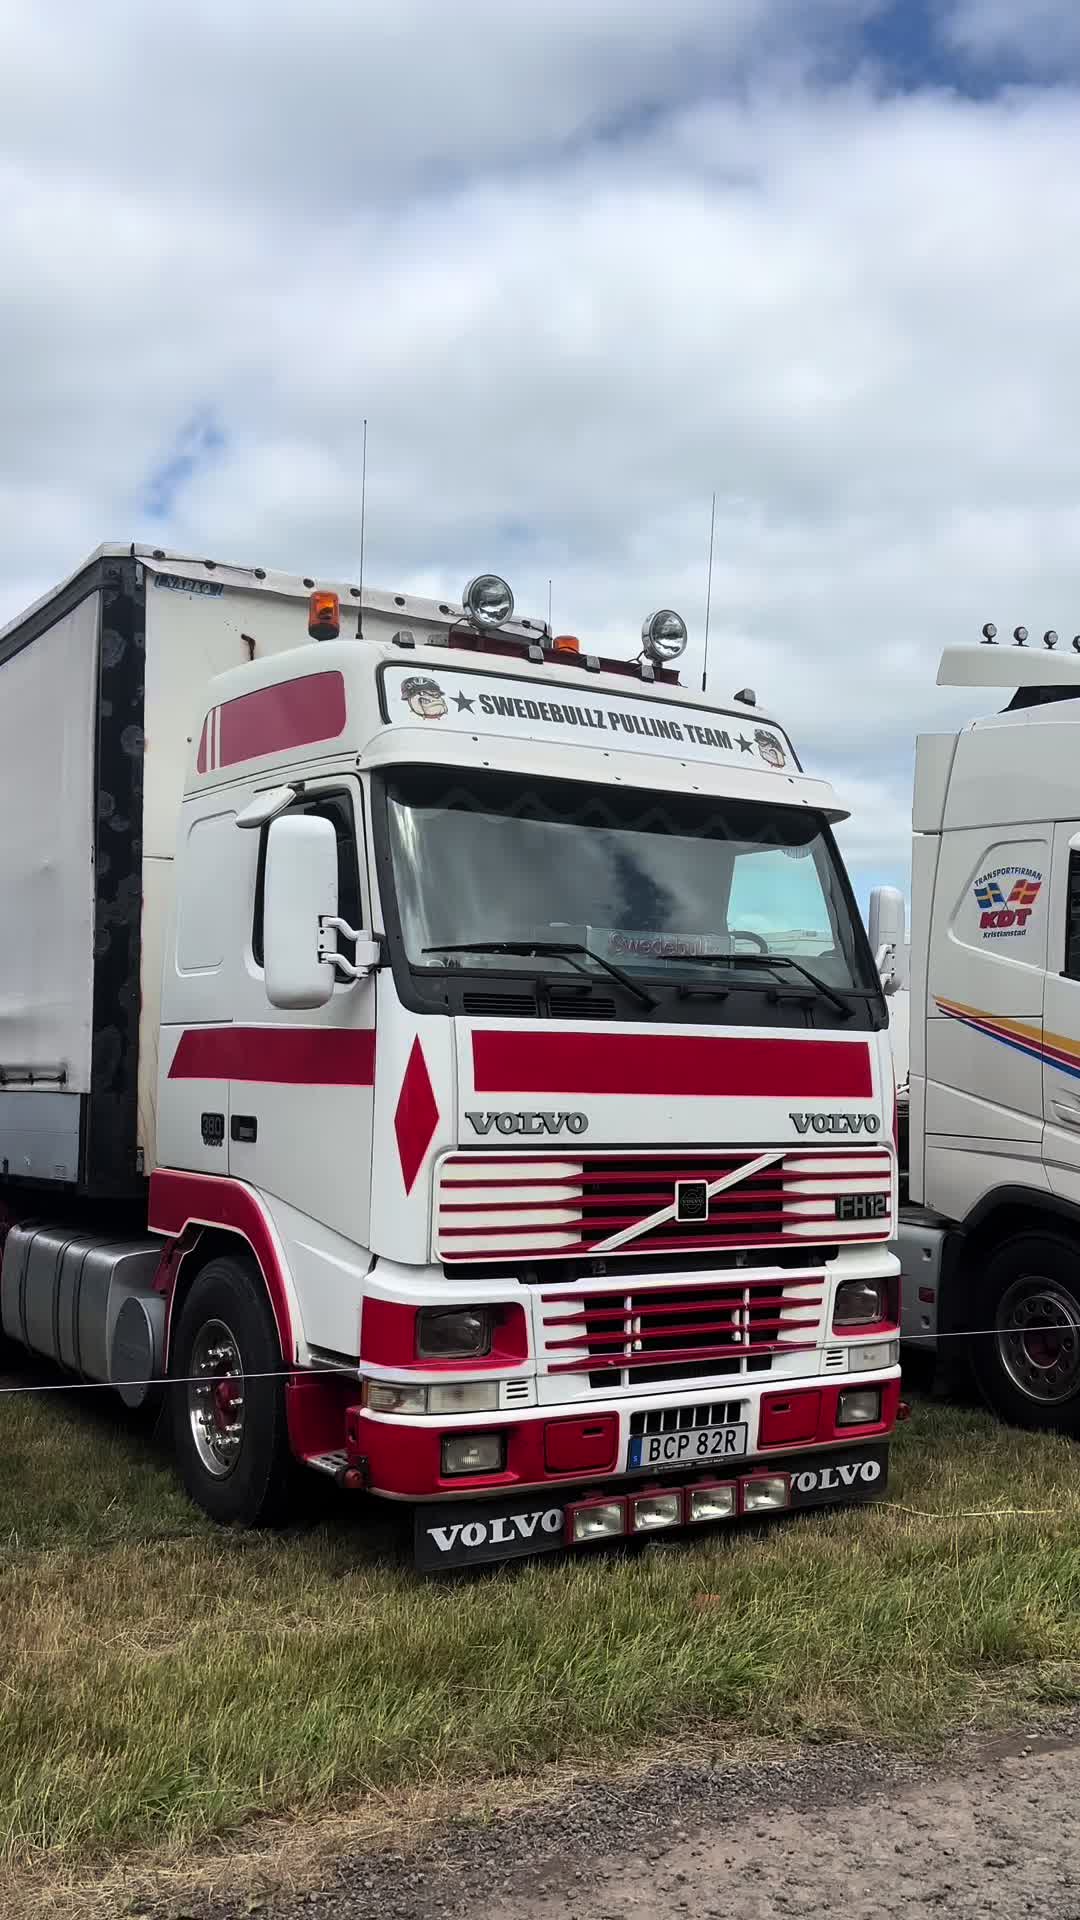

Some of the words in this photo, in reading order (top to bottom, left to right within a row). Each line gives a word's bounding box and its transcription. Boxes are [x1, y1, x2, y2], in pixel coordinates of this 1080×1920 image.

[479, 693, 608, 730] SWEDEBULLZ
[607, 711, 684, 742] PULLING
[683, 723, 733, 750] TEAM
[974, 866, 1042, 887] TRANSPORTFIRMAN
[979, 908, 1032, 929] KDT
[983, 929, 1027, 938] Kristianstad
[464, 1111, 589, 1135] VOLVO
[788, 1112, 881, 1134] VOLVO
[840, 1194, 886, 1219] FH12
[649, 1434, 690, 1461] BCP
[696, 1429, 736, 1455] 82R
[426, 1508, 565, 1552] VOLVO
